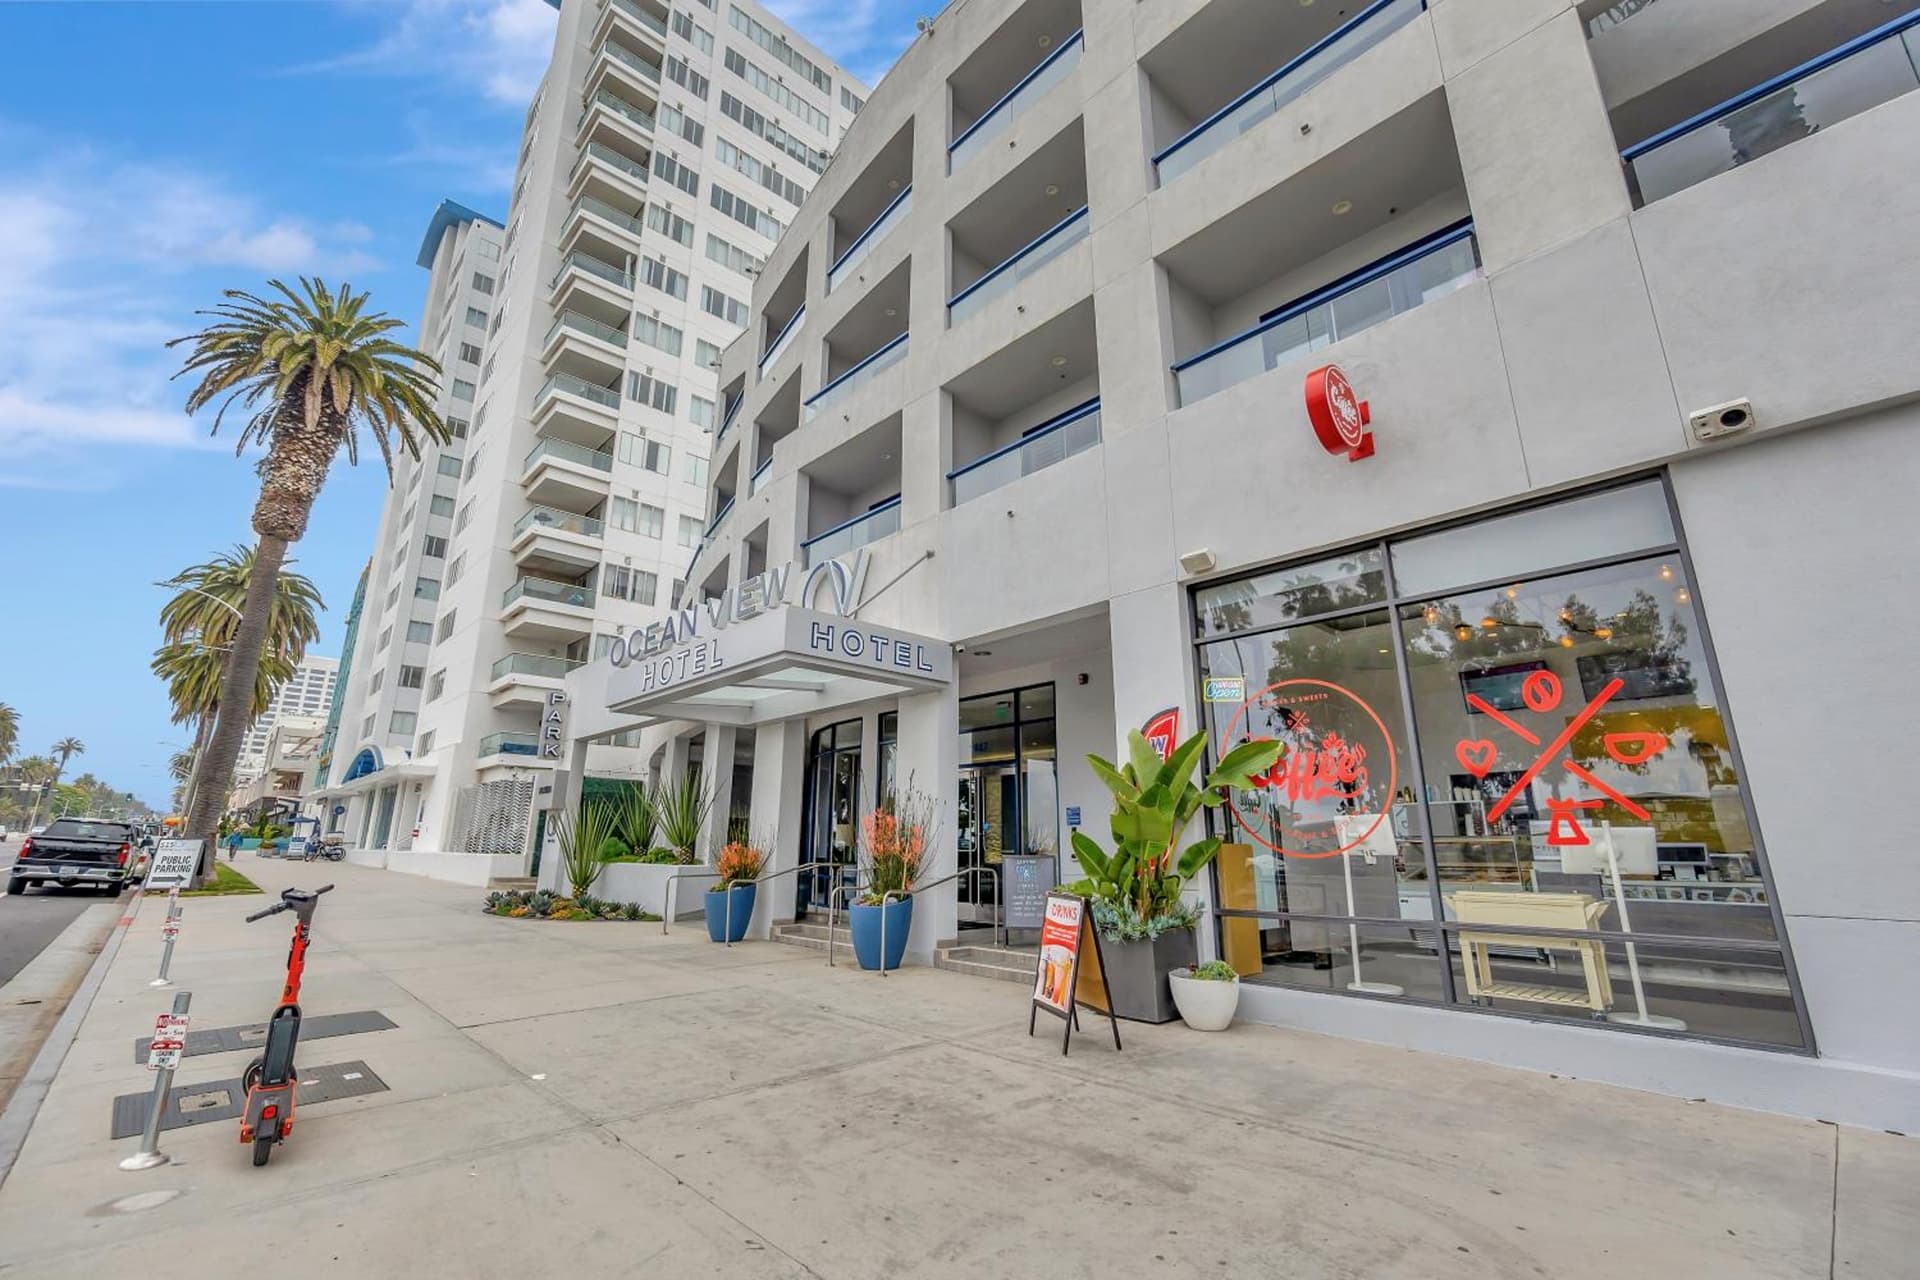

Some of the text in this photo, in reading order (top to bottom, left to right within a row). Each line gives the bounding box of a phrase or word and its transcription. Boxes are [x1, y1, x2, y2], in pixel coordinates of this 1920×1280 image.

[610, 561, 792, 668] OCEAN VIEW
[642, 638, 723, 692] HOTEL
[810, 622, 933, 672] HOTEL
[544, 692, 566, 757] PARK
[154, 864, 192, 873] PARKING
[160, 855, 191, 864] PUBLIC
[1051, 903, 1078, 921] DRINKS
